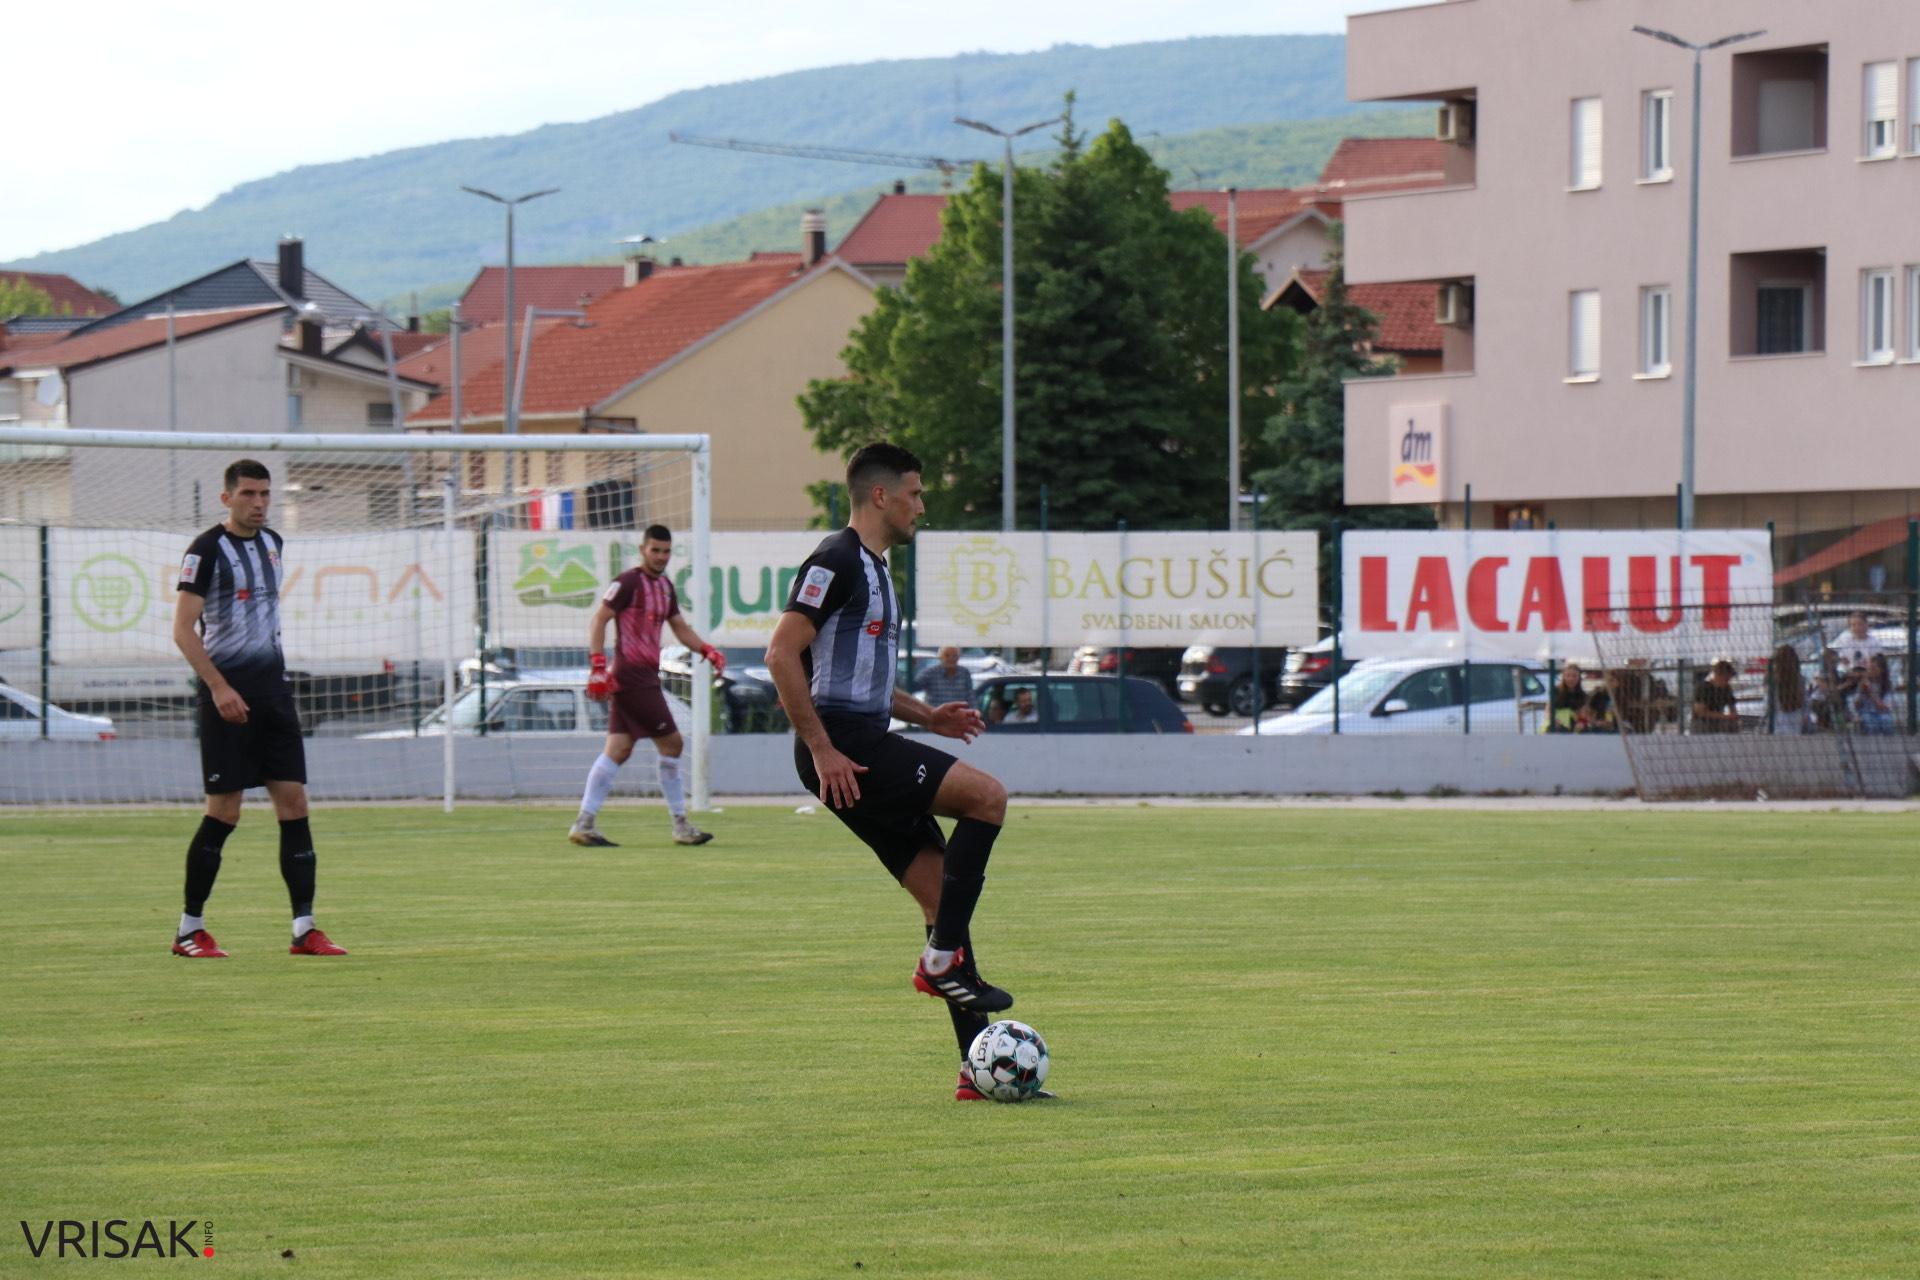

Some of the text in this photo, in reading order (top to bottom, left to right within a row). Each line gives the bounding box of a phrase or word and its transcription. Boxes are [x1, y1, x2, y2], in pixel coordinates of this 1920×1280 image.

[1401, 418, 1432, 463] dm
[969, 561, 998, 602] B
[1047, 549, 1294, 599] BAGUŠIĆ
[1360, 555, 1742, 633] LACALUT
[1081, 613, 1257, 630] SVADBENI SALON
[977, 1025, 998, 1063] SELECT
